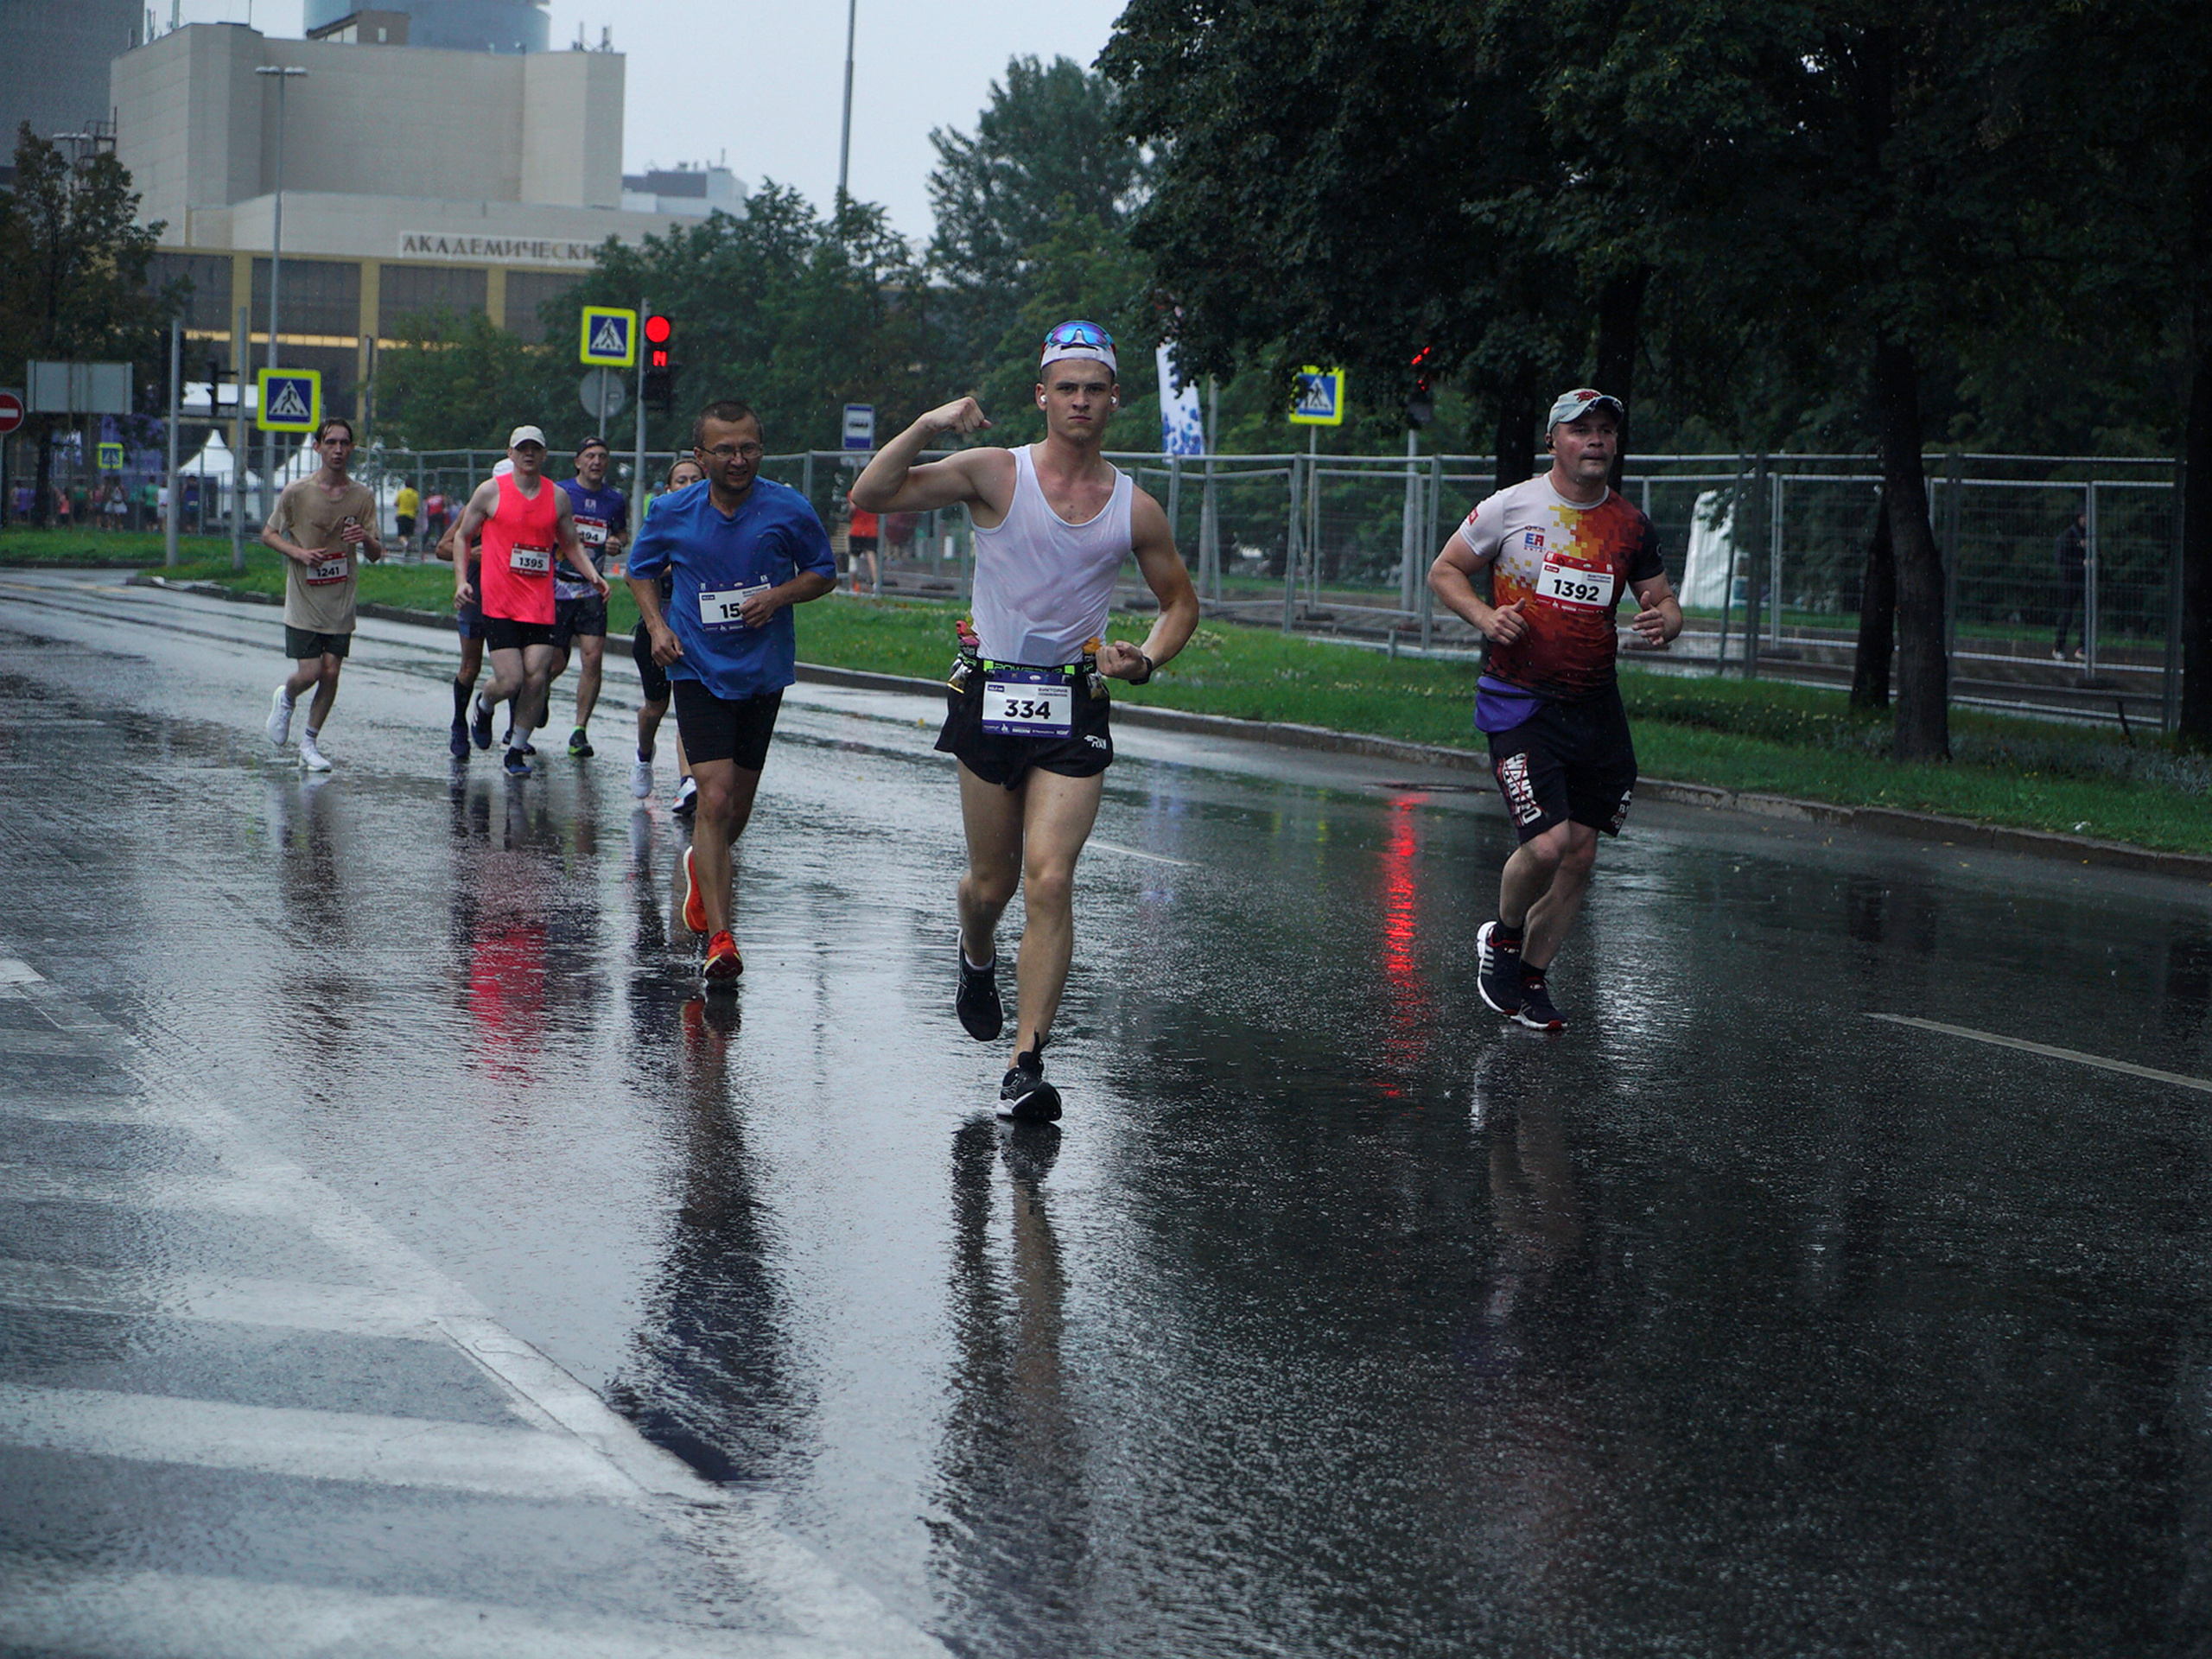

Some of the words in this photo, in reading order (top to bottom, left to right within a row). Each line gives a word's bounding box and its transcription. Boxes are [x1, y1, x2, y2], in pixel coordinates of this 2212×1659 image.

[519, 556, 543, 569] 1395
[316, 566, 340, 577] 1241
[1554, 579, 1599, 601] 1392
[720, 603, 743, 619] 15
[1004, 698, 1051, 719] 334
